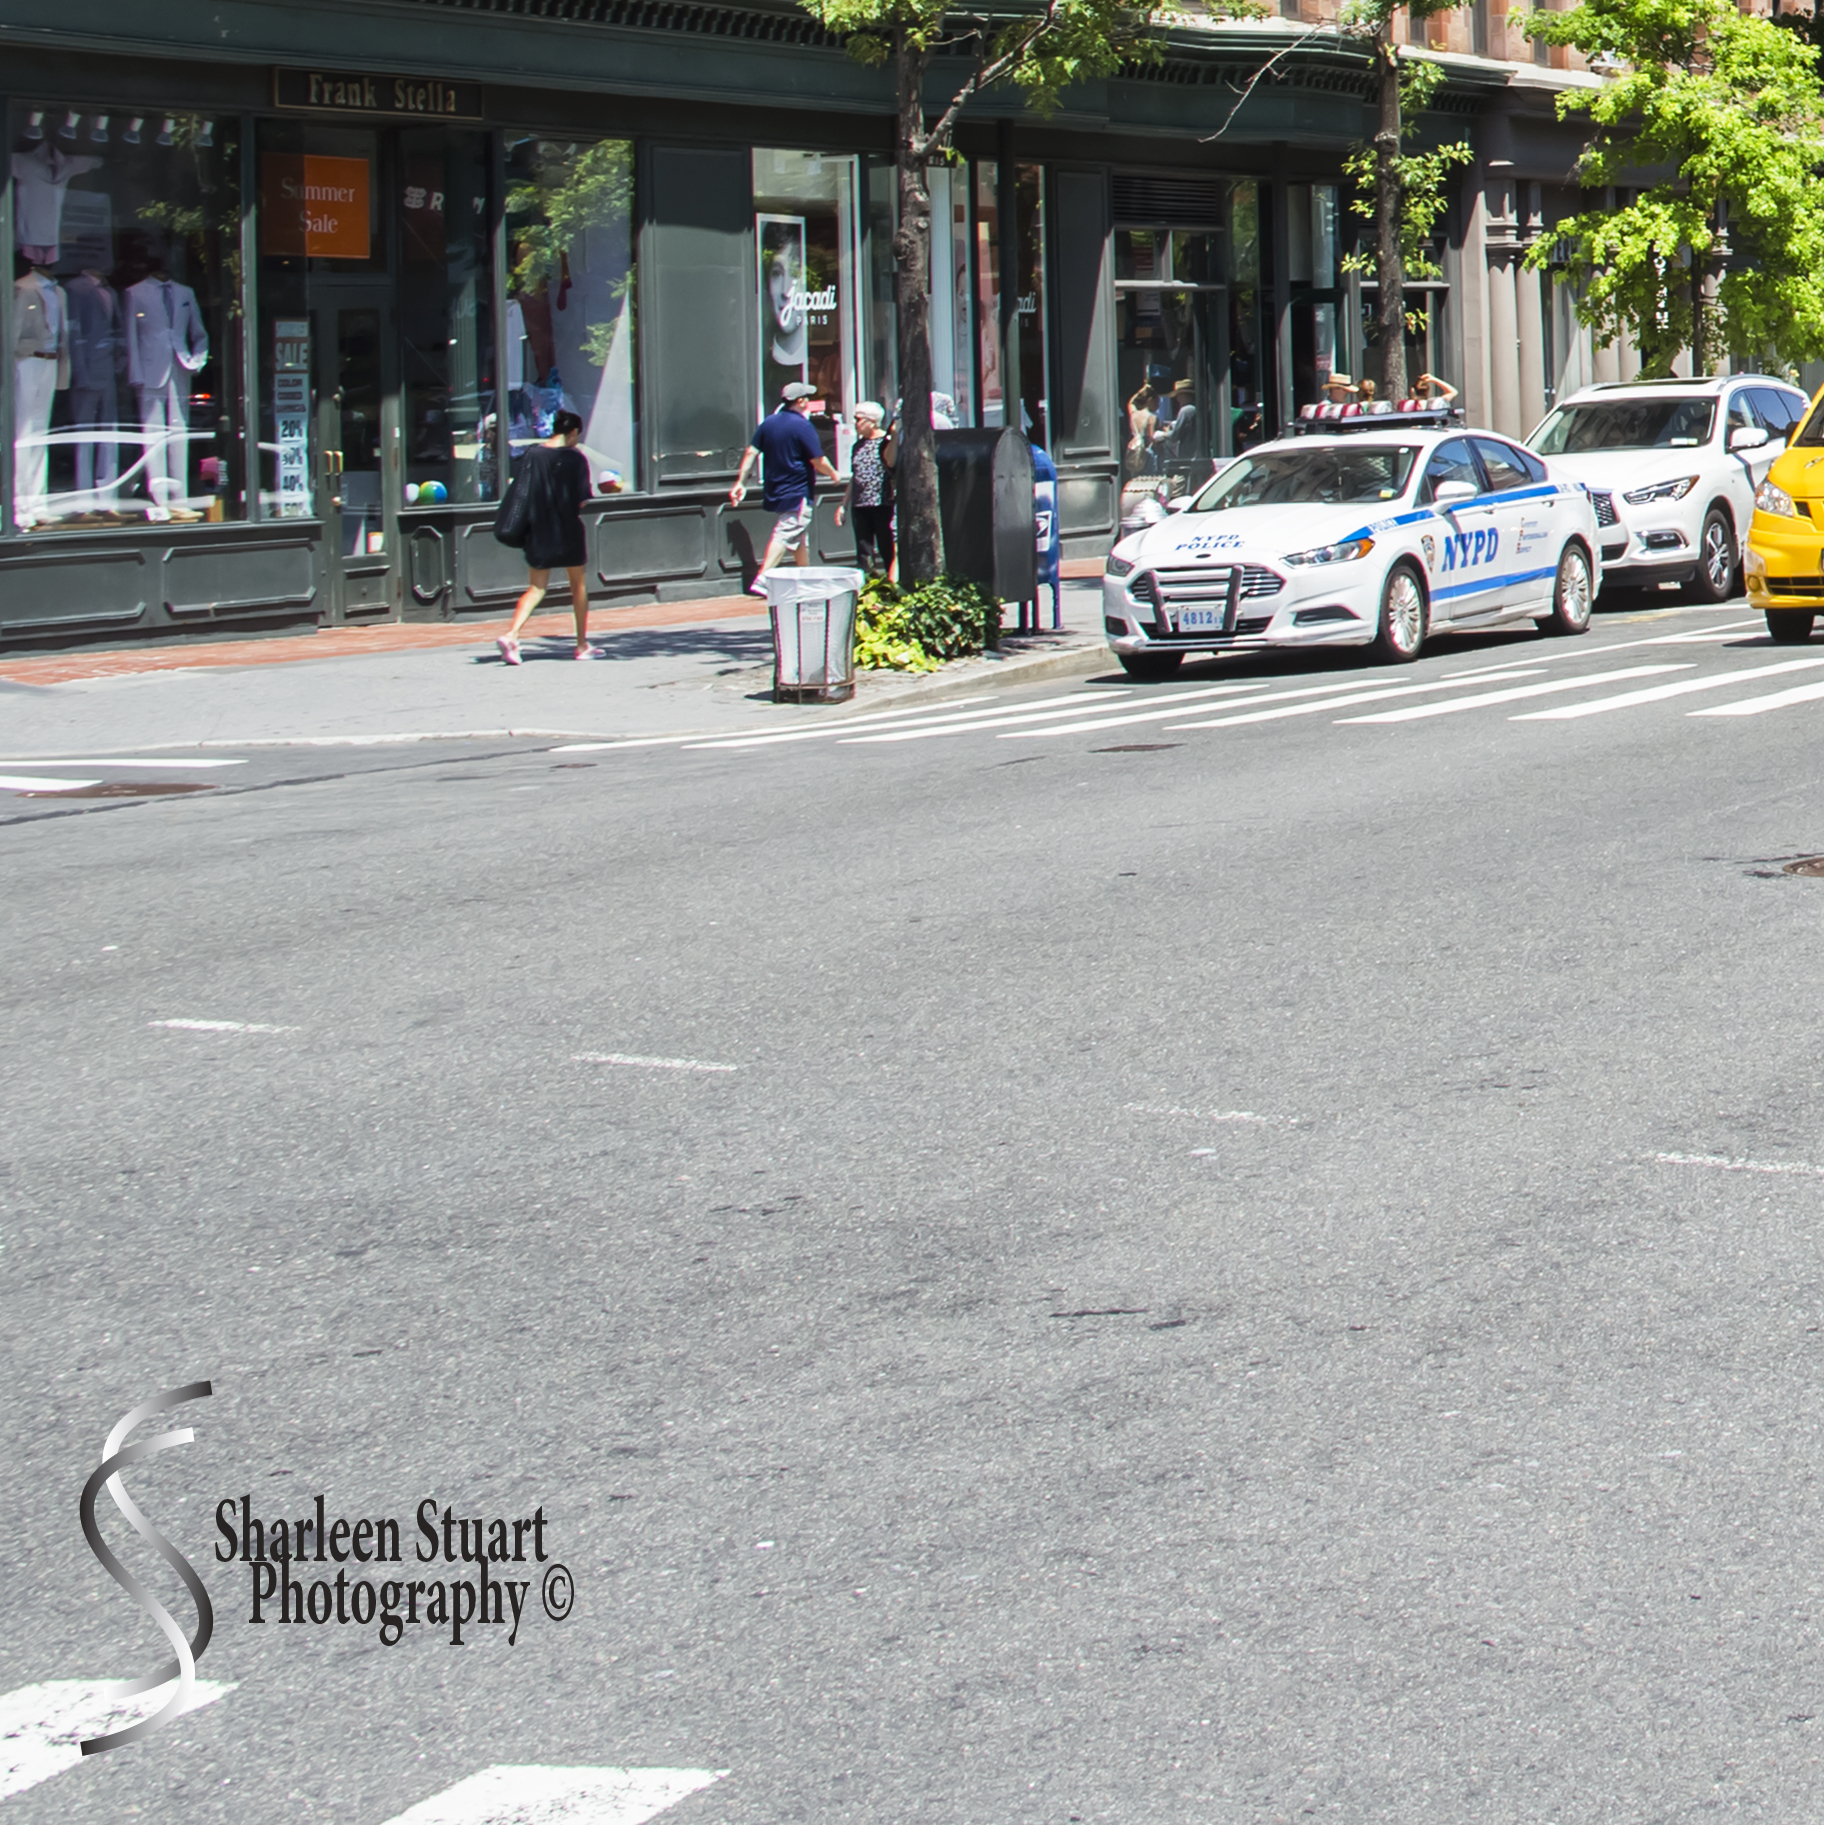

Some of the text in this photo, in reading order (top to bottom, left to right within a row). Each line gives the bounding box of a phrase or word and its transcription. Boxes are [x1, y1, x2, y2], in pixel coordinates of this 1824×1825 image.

[308, 72, 457, 113] Frank Stella
[280, 176, 356, 203] Summer
[299, 210, 339, 234] Sale
[780, 279, 838, 327] jacadi
[796, 314, 828, 326] PARIS
[275, 342, 309, 372] SALE
[1174, 540, 1246, 551] POLICE
[1191, 534, 1240, 543] NYPD
[1441, 527, 1499, 573] NYPD
[1183, 611, 1213, 626] 4812
